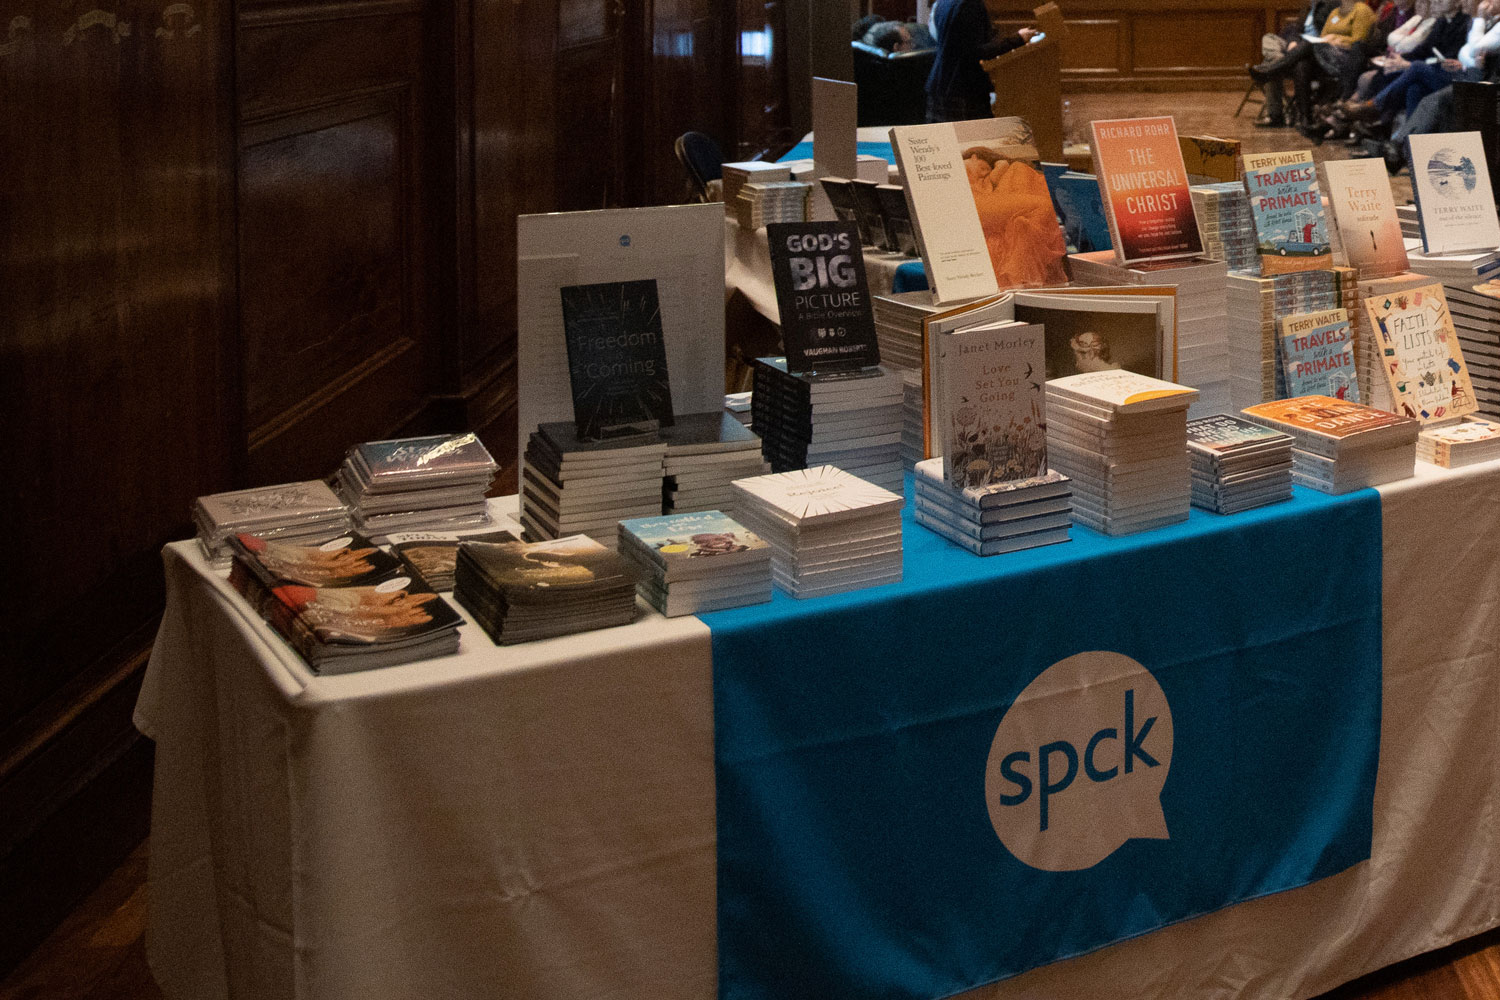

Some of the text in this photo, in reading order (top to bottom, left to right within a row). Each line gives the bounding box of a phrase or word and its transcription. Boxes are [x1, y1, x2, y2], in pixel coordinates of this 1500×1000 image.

[1099, 123, 1170, 140] RICHARD ROHR
[908, 137, 928, 146] Sister
[910, 146, 941, 155] Wendy's
[1127, 147, 1155, 166] THE
[1250, 153, 1306, 170] TERRY WAITE
[918, 171, 952, 182] Paintings
[1111, 168, 1183, 192] UNIVERSAL
[1254, 168, 1312, 188] TRAVELS
[1259, 191, 1318, 212] PRIMATE
[1345, 186, 1378, 200] Terry
[1126, 193, 1178, 215] CHRIST
[1347, 200, 1381, 212] Waite
[1432, 204, 1485, 215] TERRY WAITE
[786, 232, 851, 252] GOD'S
[789, 254, 857, 291] BIG
[795, 291, 861, 310] PICTURE
[1289, 312, 1341, 333] TERRY WAITE
[1394, 312, 1429, 335] FAITH
[577, 330, 657, 352] Freedom
[956, 337, 1036, 356] Janet Morley
[1292, 328, 1346, 352] TRAVELS
[1403, 330, 1433, 350] LISTS
[586, 359, 656, 379] Coming
[983, 364, 1011, 375] Love
[1296, 352, 1351, 378] PRIMATE
[976, 376, 1019, 391] Set You
[980, 392, 1016, 404] Going
[1316, 411, 1387, 430] DANCE
[999, 689, 1161, 832] spck
